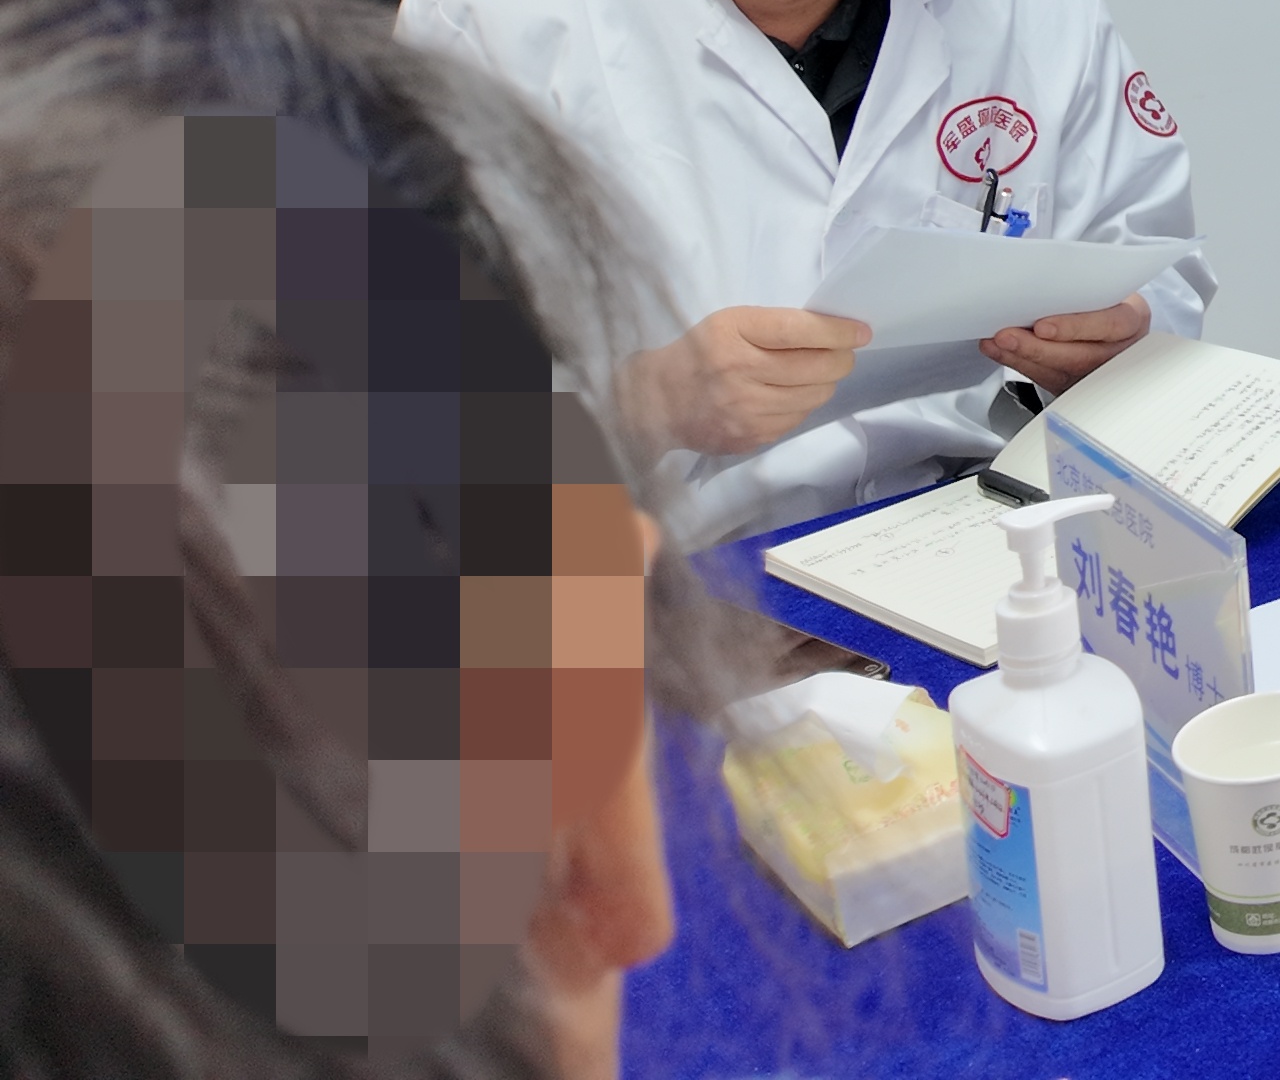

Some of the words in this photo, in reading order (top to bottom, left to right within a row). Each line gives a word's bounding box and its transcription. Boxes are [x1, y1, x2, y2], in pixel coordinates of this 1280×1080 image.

[1071, 536, 1180, 681] 刘春艳
[1185, 654, 1225, 708] 博士
